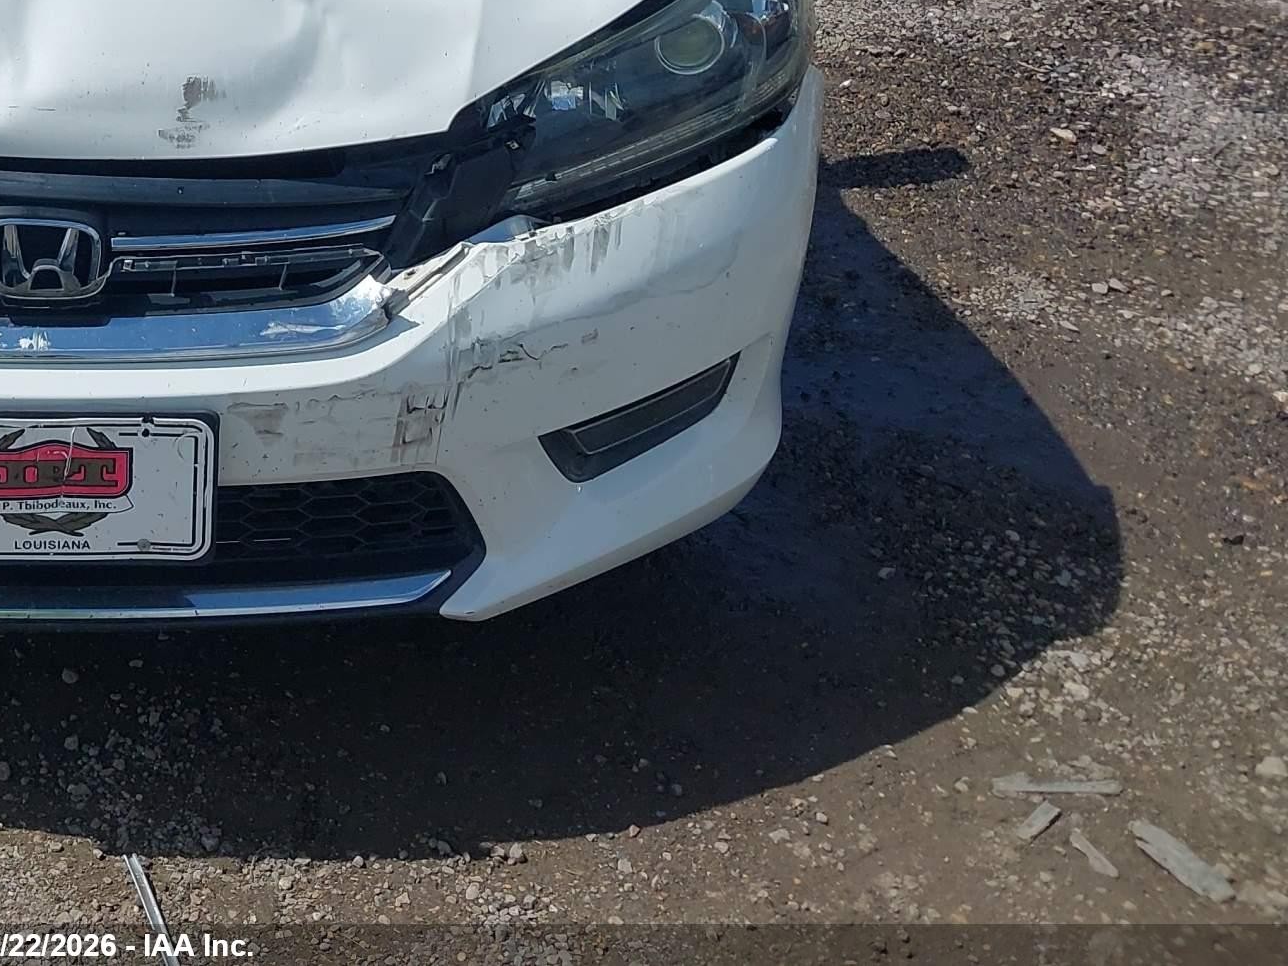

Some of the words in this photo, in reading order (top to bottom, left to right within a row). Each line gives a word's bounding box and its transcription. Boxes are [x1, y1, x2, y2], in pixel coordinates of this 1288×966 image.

[2, 501, 14, 510] P.
[94, 500, 117, 509] Inc.
[14, 540, 91, 550] LOUISIANA
